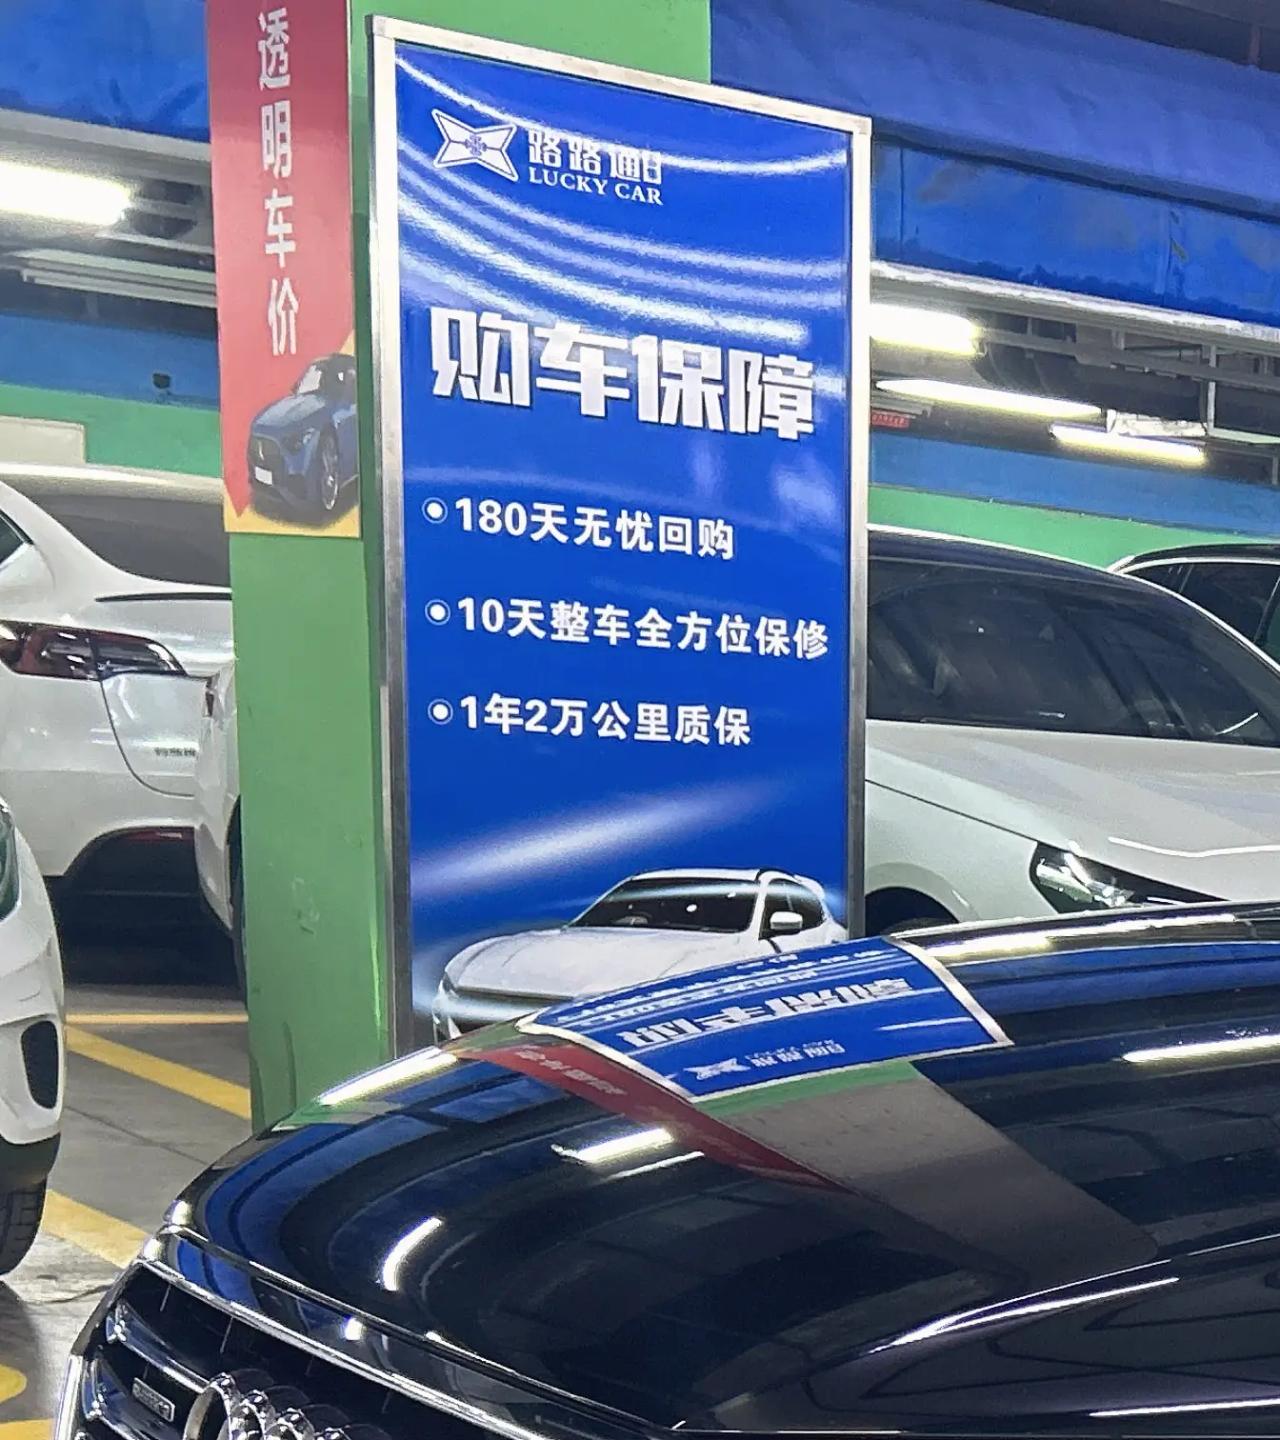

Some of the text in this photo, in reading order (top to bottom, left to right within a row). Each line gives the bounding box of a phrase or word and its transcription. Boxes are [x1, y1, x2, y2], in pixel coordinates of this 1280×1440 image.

[256, 6, 300, 356] 透明车价
[528, 166, 664, 206] LUCKY CAR
[430, 307, 815, 440] 购车保障
[455, 497, 735, 561] 180天无忧回购
[457, 597, 829, 660] 10天整车全方位保修
[460, 692, 751, 746] 1年2万公里质保
